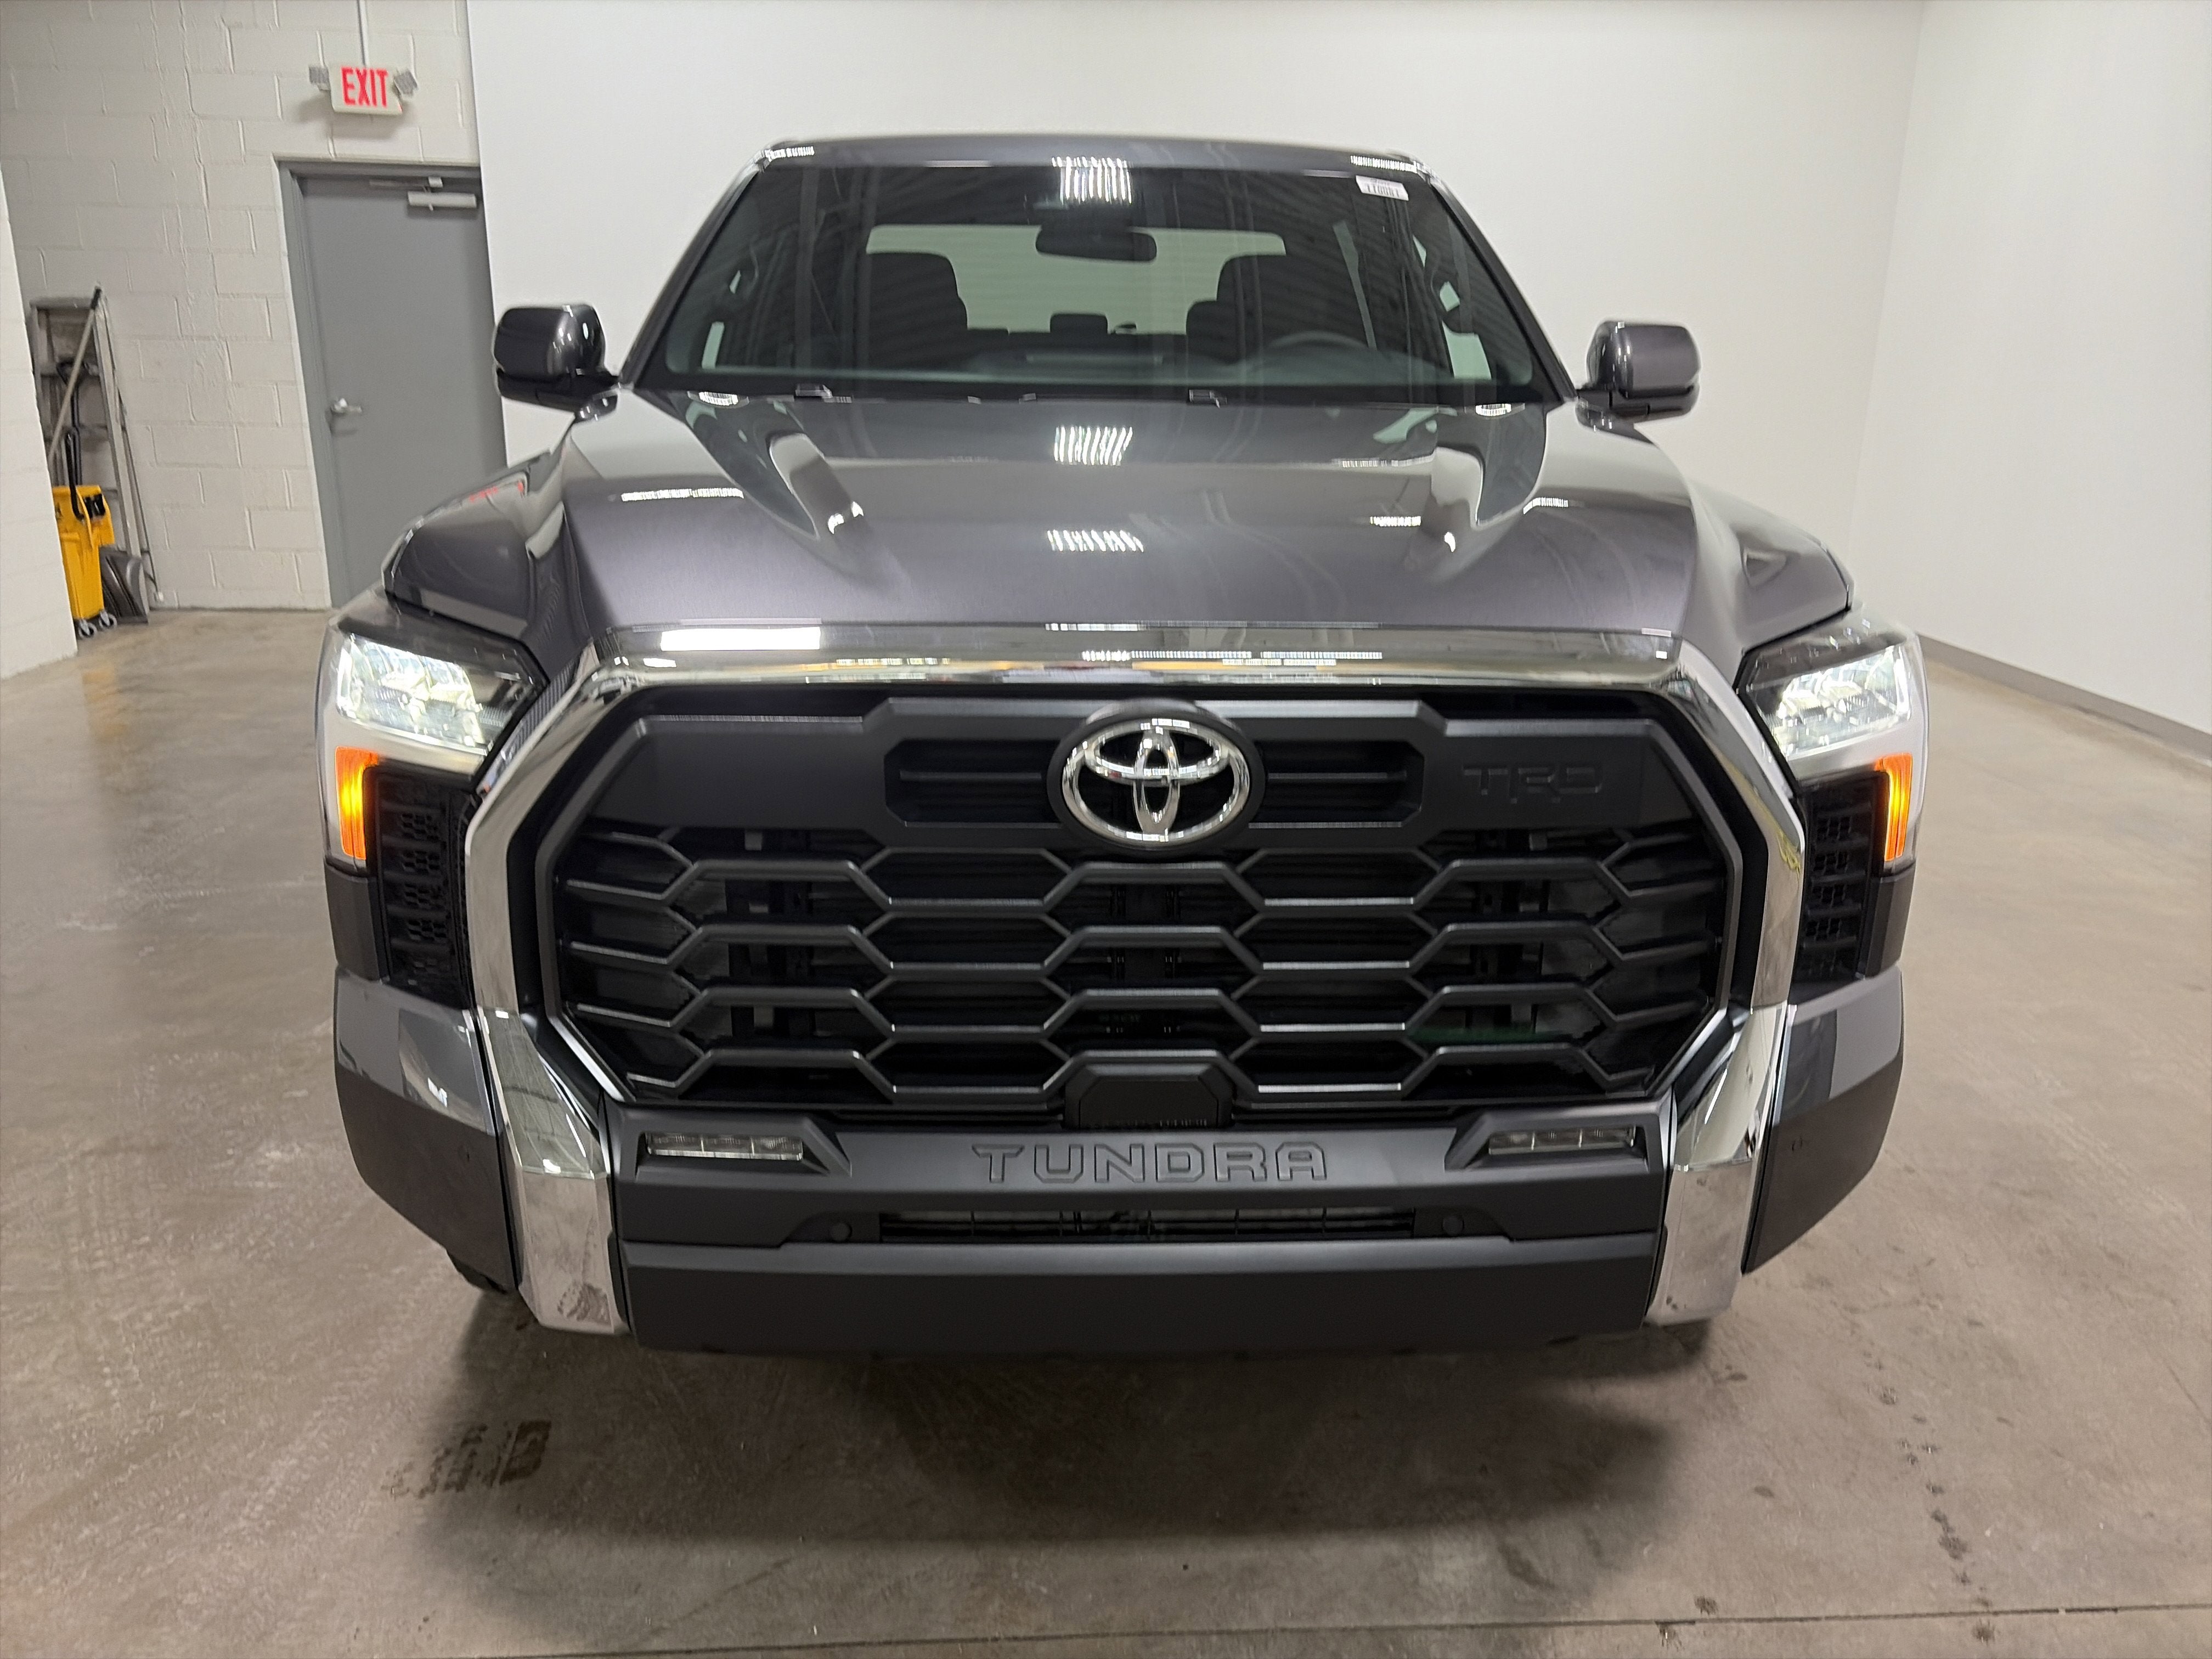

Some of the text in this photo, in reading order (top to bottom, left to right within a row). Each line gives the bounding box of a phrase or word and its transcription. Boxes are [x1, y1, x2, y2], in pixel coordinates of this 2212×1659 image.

[341, 66, 388, 108] EXIT
[1462, 764, 1602, 804] TRD
[972, 1141, 1327, 1184] TUNDRA
